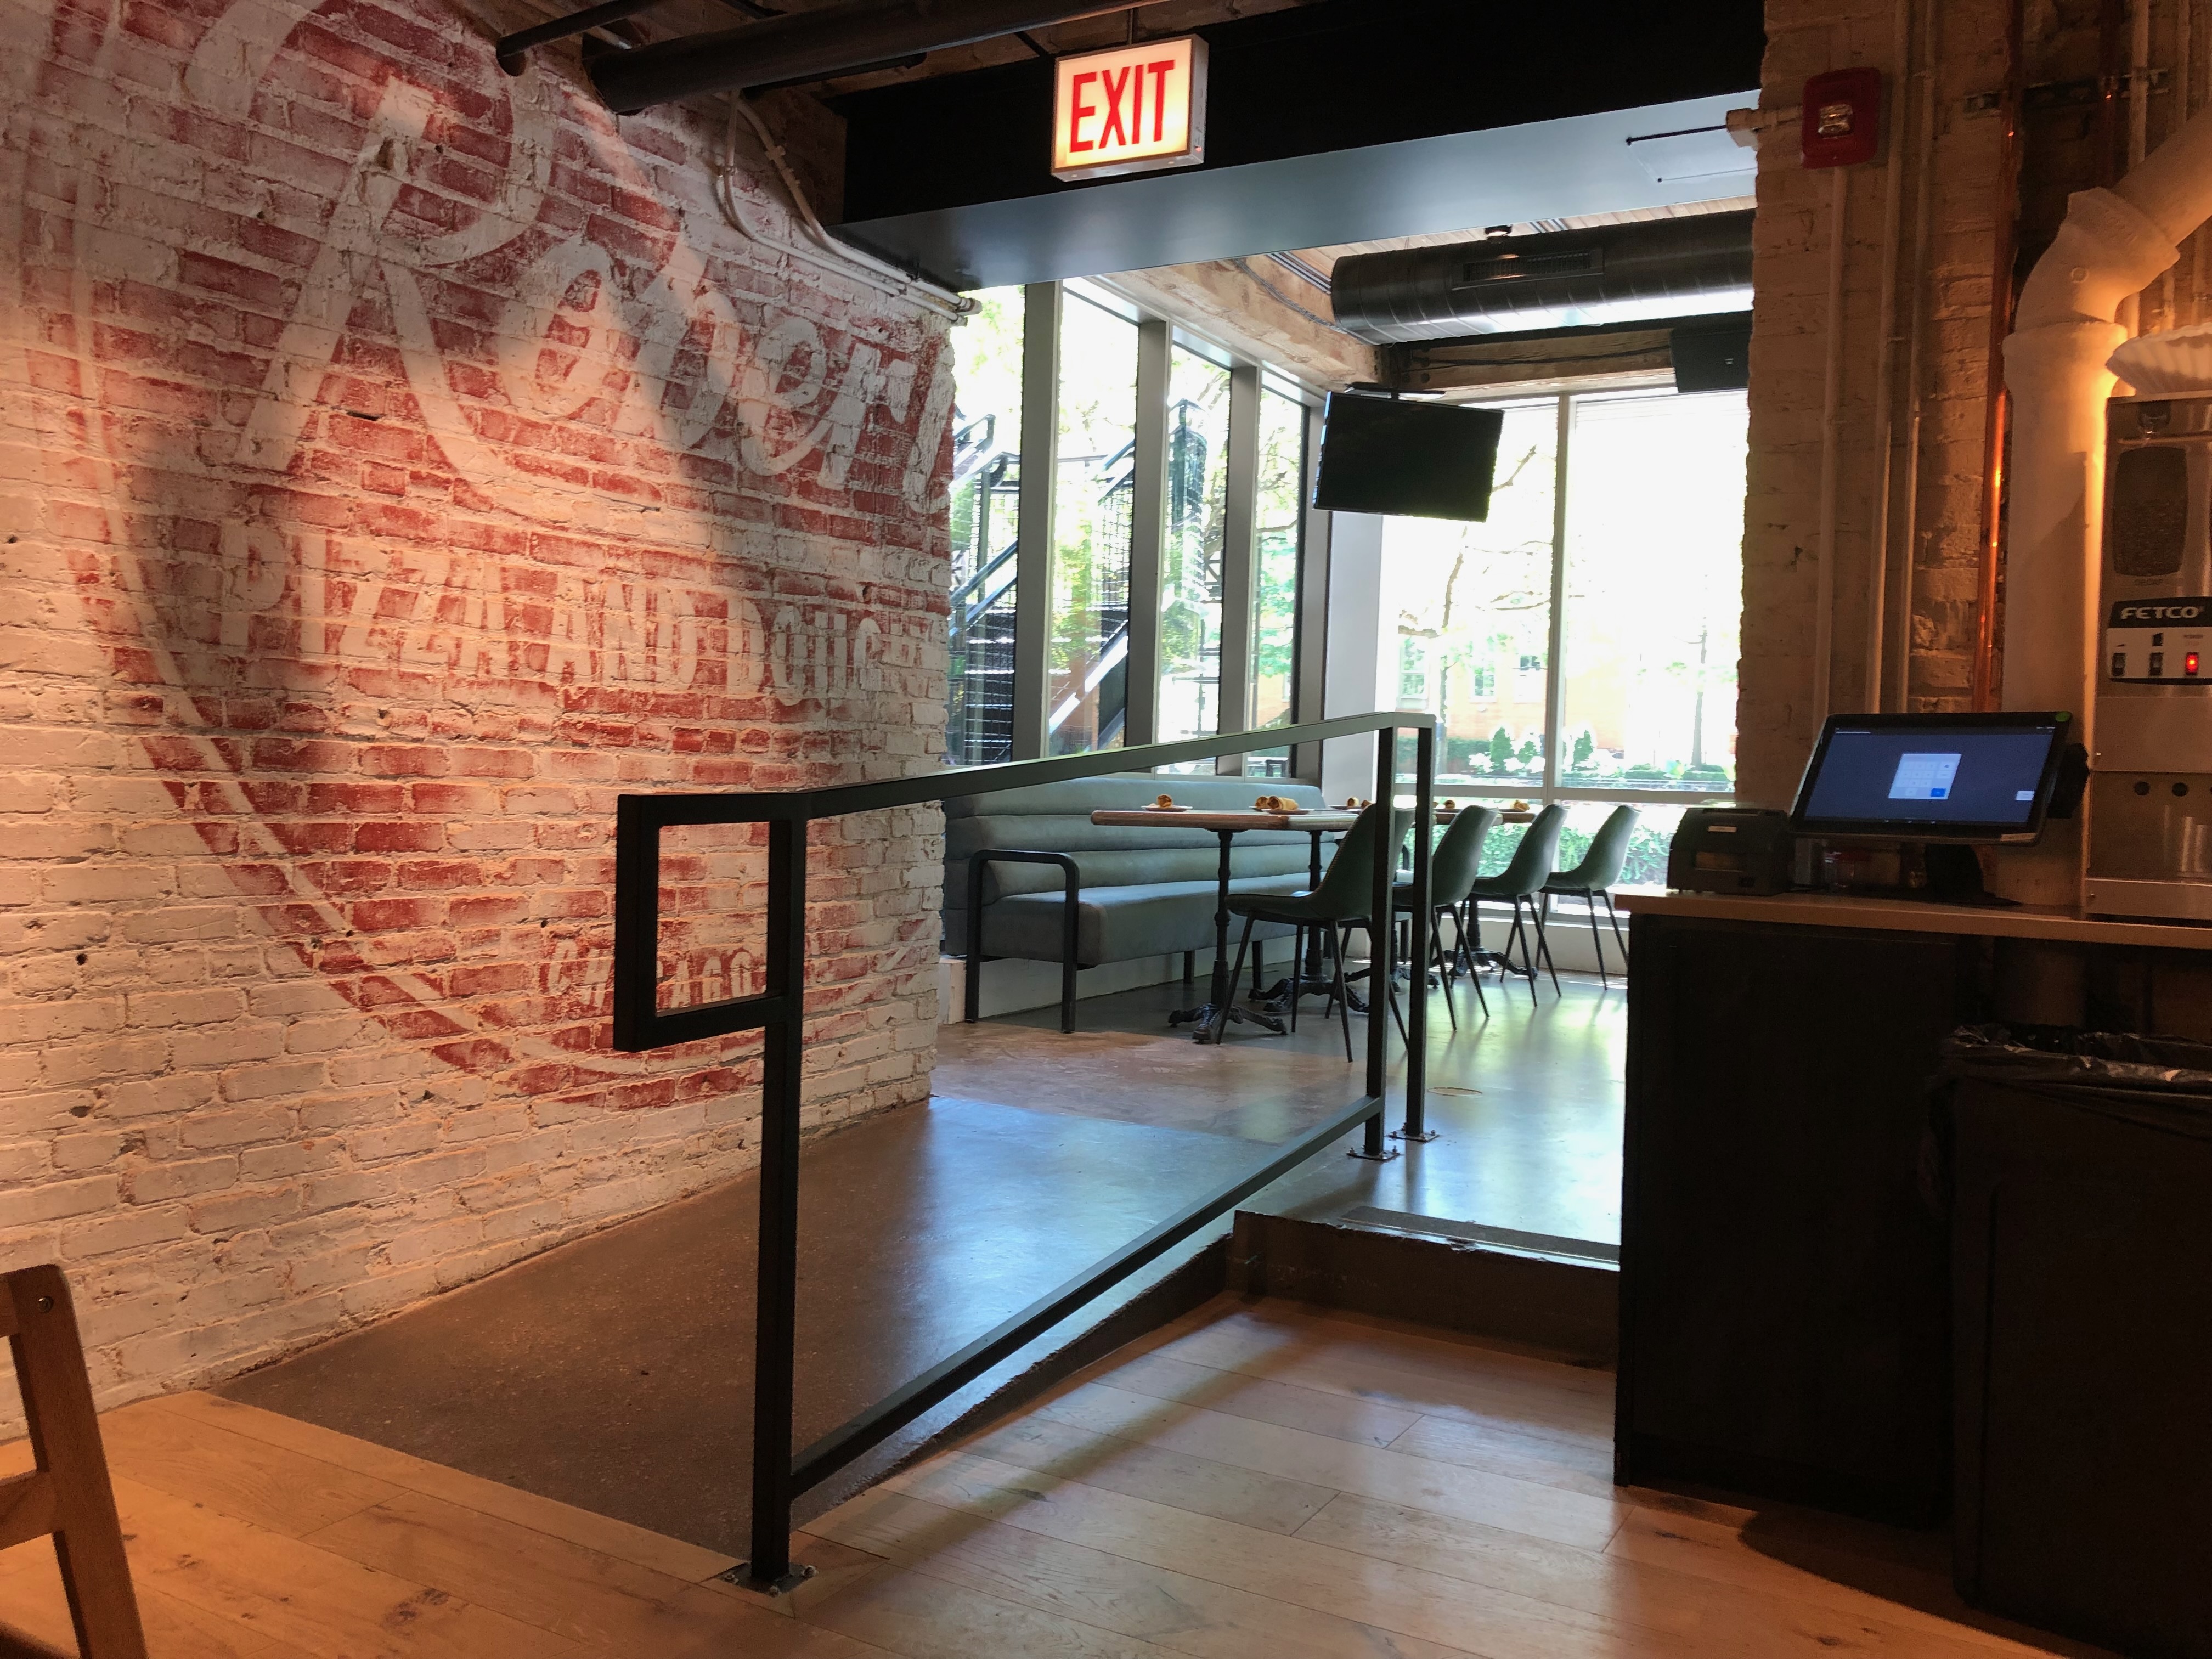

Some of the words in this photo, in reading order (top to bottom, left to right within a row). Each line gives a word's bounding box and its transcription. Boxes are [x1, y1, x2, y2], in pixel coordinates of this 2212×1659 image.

[1070, 60, 1175, 153] EXIT
[221, 518, 511, 680] PIZZA
[548, 573, 699, 692] AND
[2120, 606, 2199, 619] FETCO
[548, 938, 753, 1009] CHAGO
